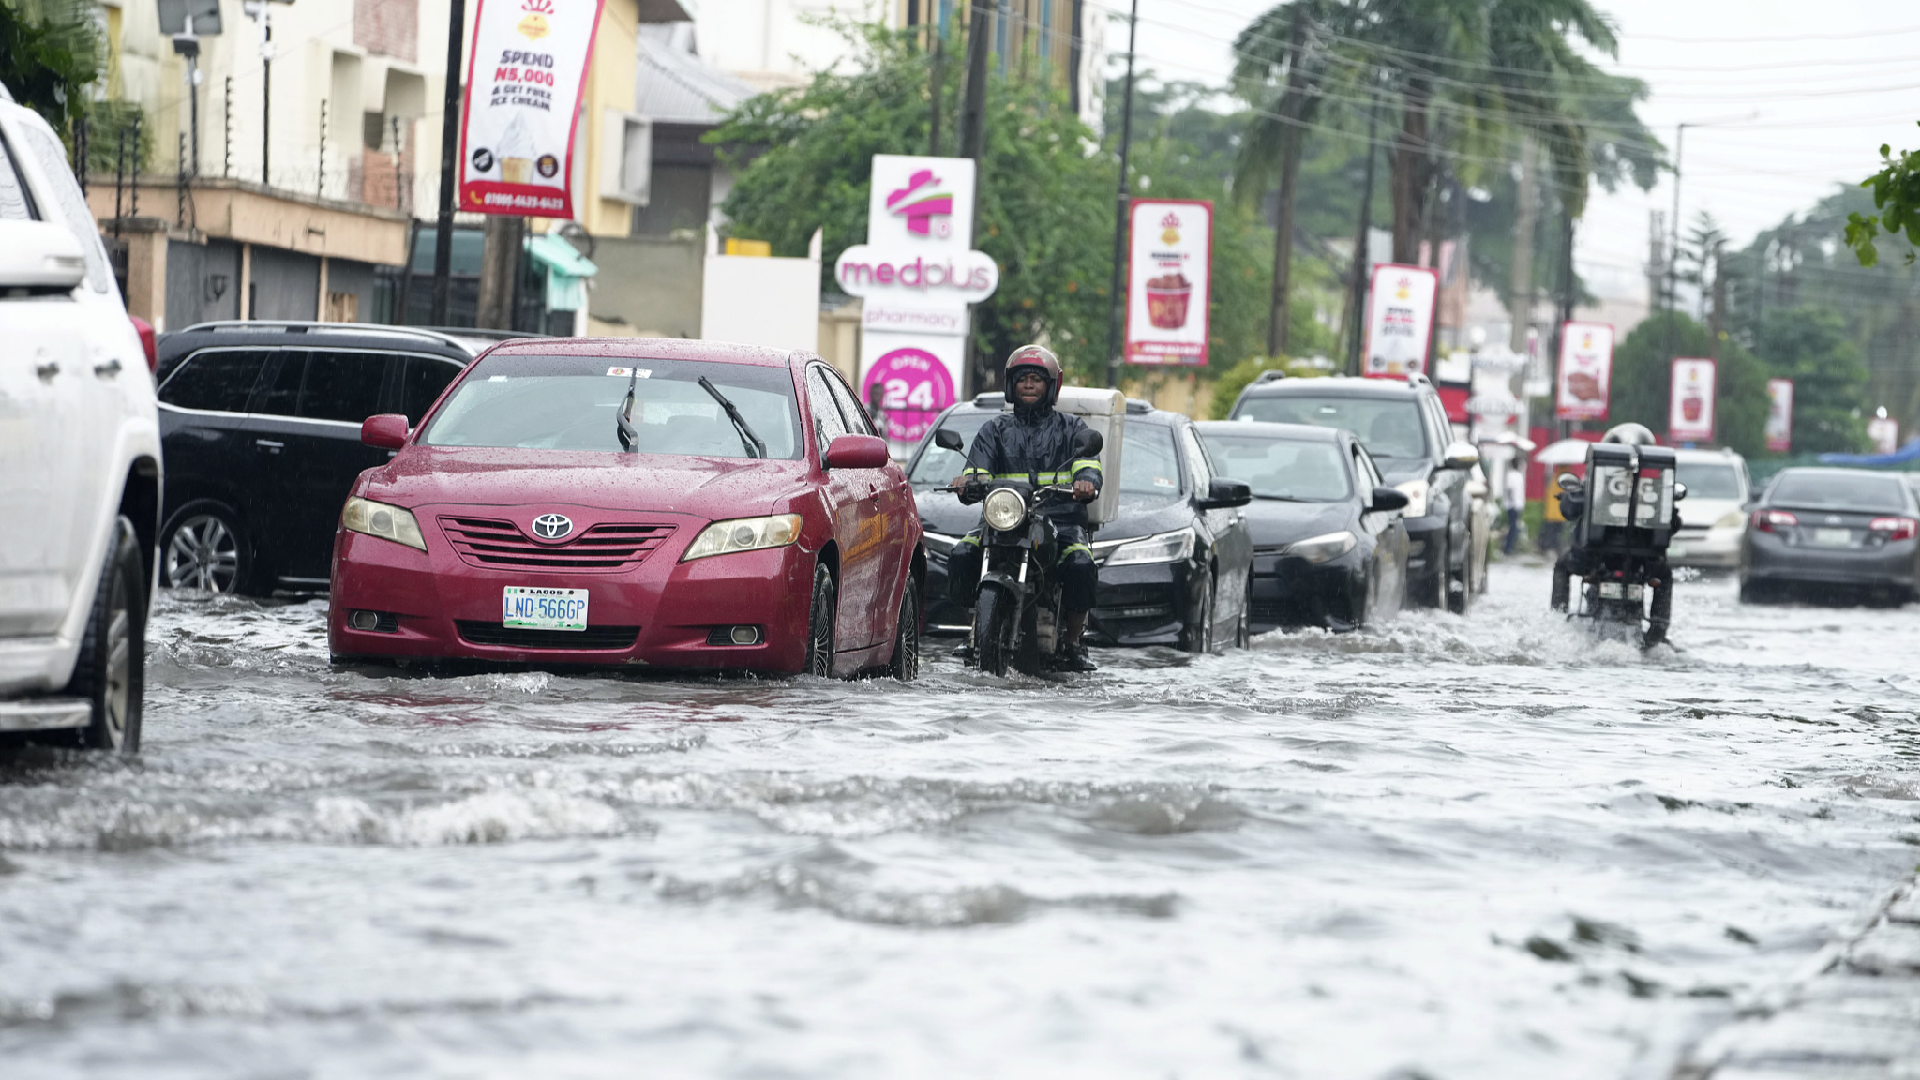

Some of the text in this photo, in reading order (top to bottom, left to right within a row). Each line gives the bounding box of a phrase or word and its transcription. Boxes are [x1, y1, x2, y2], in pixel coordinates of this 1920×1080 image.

[500, 50, 554, 69] SPEND
[503, 85, 523, 94] GET
[527, 86, 552, 100] FREE
[489, 97, 551, 112] ICE CREAM
[841, 256, 991, 292] medplus
[866, 309, 960, 328] pharmacy
[890, 355, 931, 371] OPEN
[883, 378, 935, 411] 24
[529, 588, 564, 596] LAGOS
